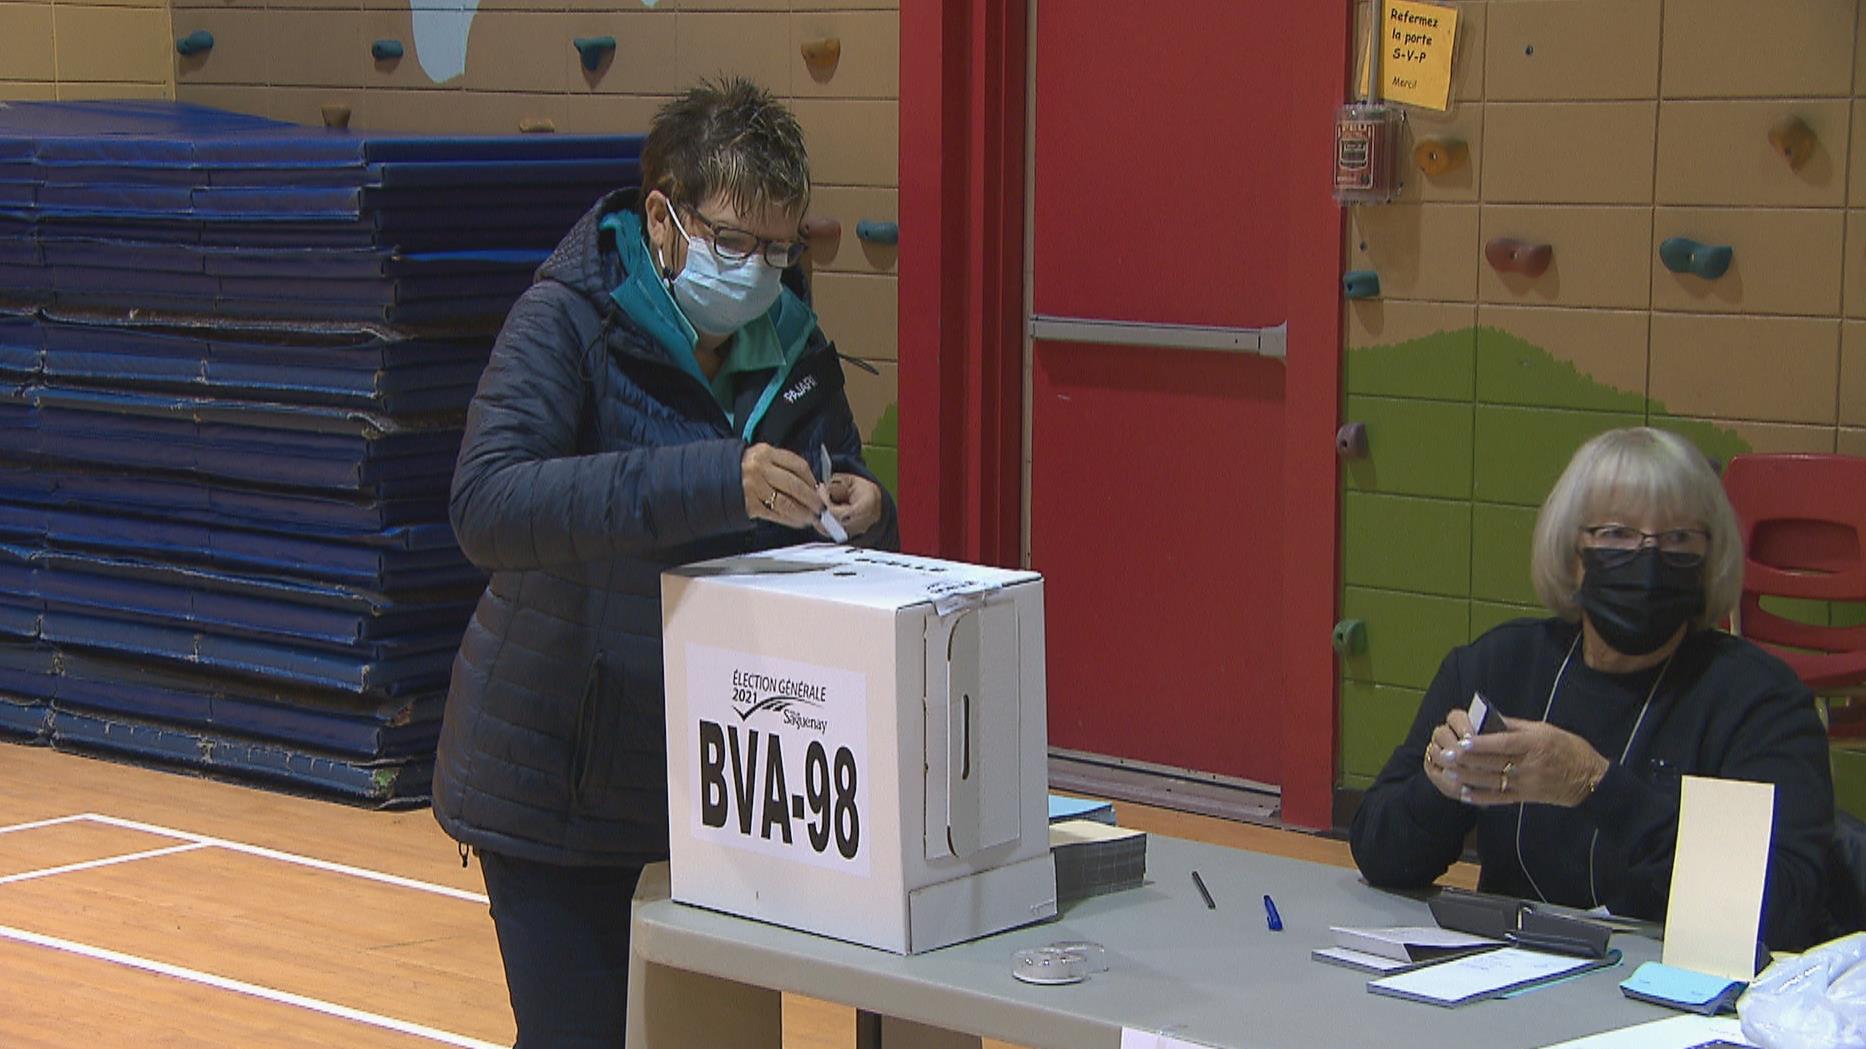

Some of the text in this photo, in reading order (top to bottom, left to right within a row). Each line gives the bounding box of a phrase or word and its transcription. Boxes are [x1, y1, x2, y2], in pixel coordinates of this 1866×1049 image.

[1390, 8, 1439, 28] Refermez
[1392, 27, 1433, 46] la porte
[1392, 47, 1427, 64] S-V-P
[732, 668, 827, 703] ÉLECTION GÉNÉRALE
[732, 687, 758, 704] 2021
[783, 708, 828, 735] Saguenay
[699, 718, 860, 860] BVA-98
